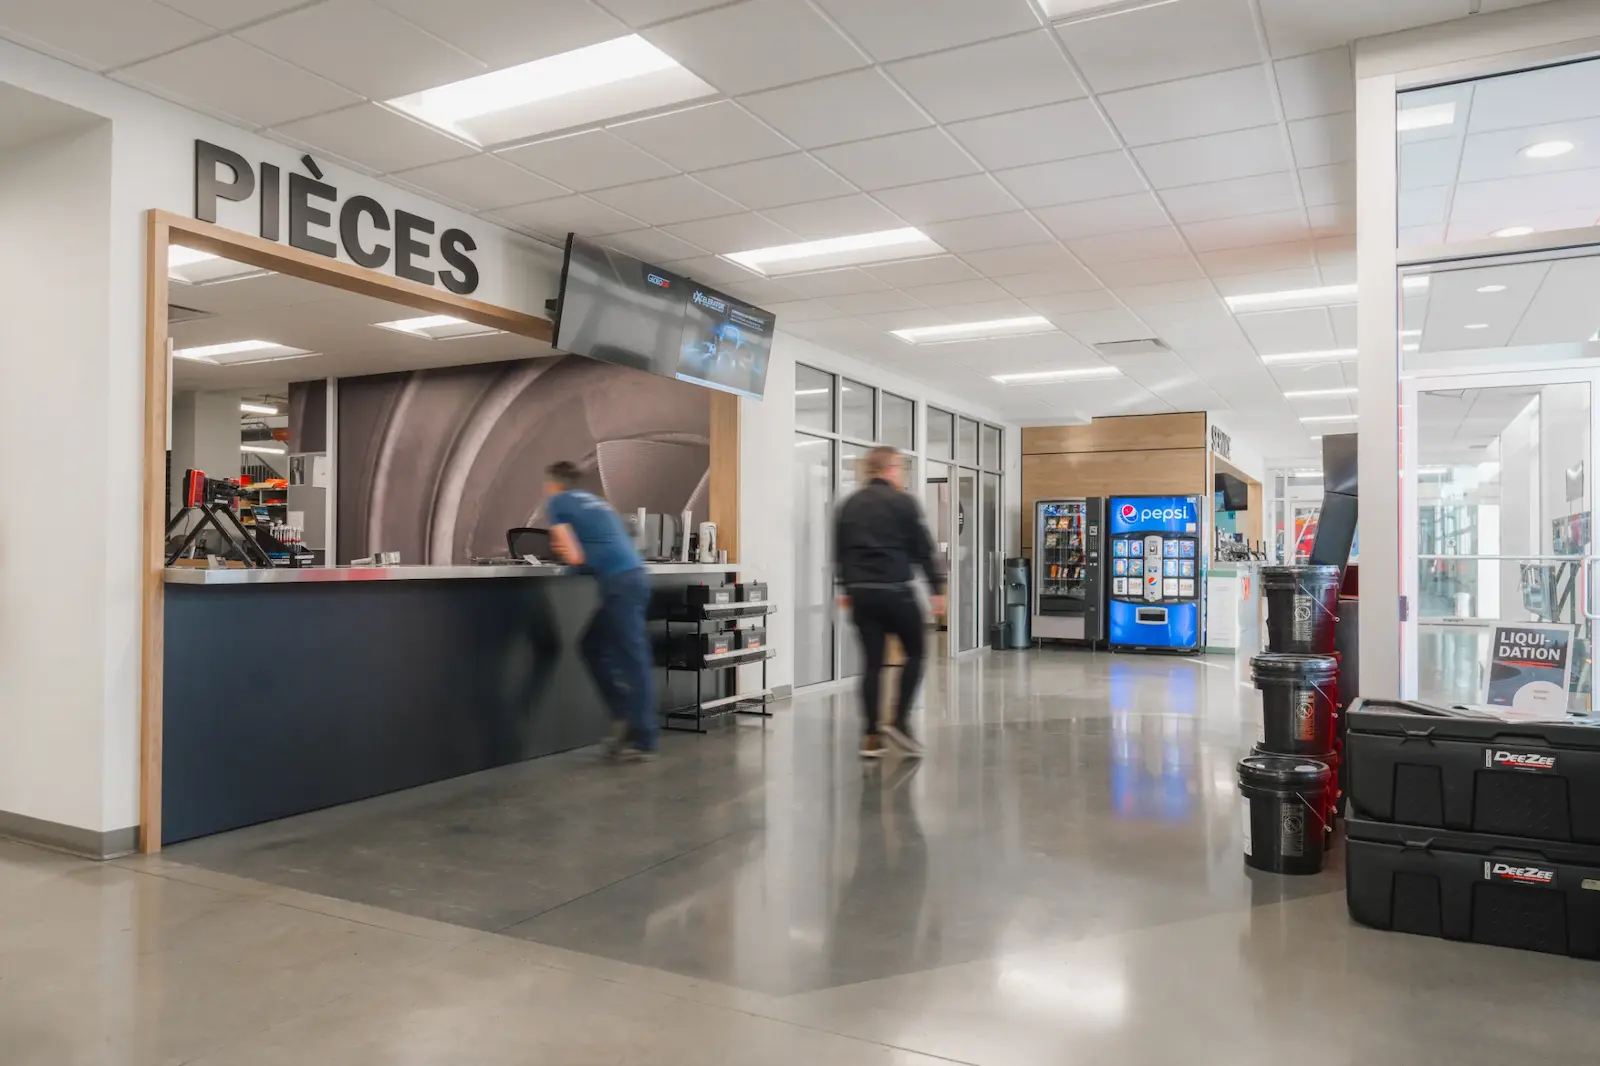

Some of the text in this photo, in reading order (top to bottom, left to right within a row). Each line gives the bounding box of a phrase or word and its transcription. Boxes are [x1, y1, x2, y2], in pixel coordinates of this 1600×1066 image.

[195, 138, 479, 295] PIÈCES
[1141, 506, 1187, 522] pepsi
[1500, 631, 1551, 646] LIQUI-
[1498, 646, 1560, 661] DATION
